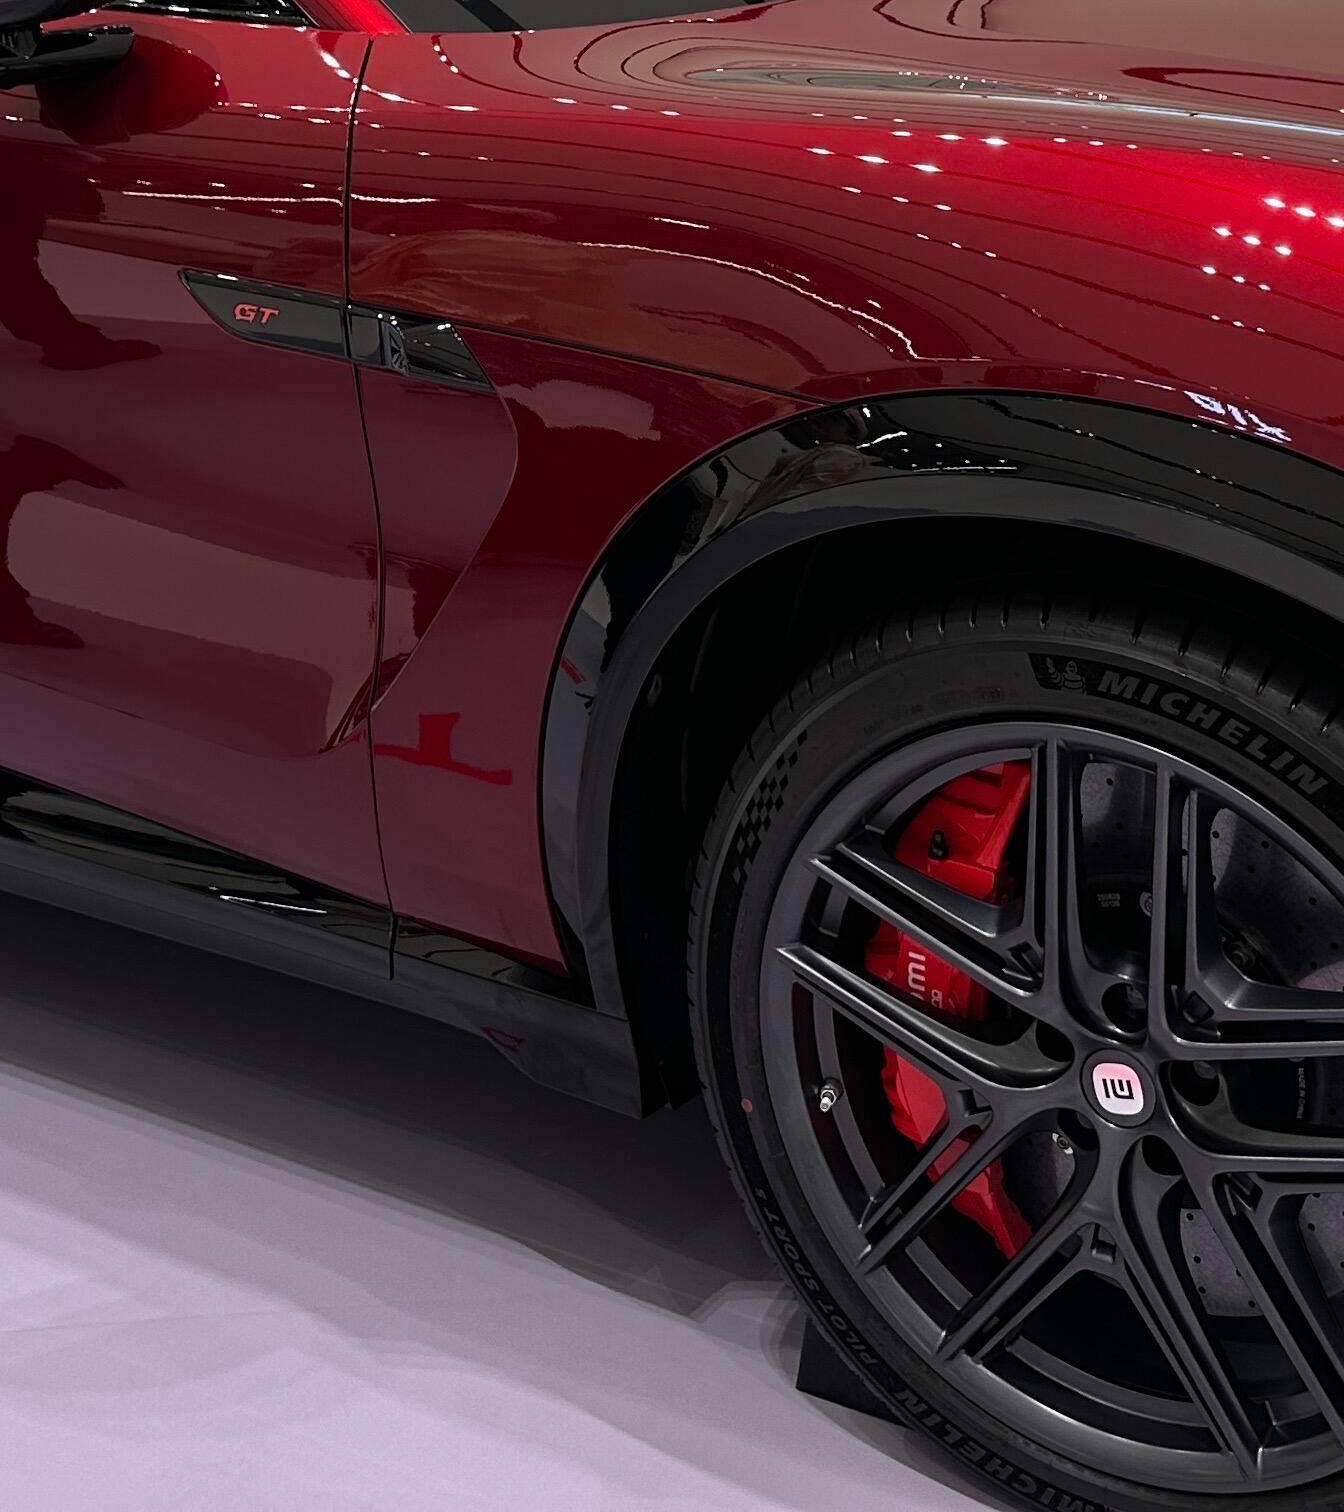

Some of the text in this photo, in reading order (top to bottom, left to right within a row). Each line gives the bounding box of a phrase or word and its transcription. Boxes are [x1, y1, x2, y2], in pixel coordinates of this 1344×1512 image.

[232, 302, 280, 326] GT
[1095, 668, 1329, 799] MICHELIN
[761, 1205, 821, 1294] SPORT
[817, 1299, 880, 1368] PILOT
[894, 1386, 1096, 1512] MICHELIN
